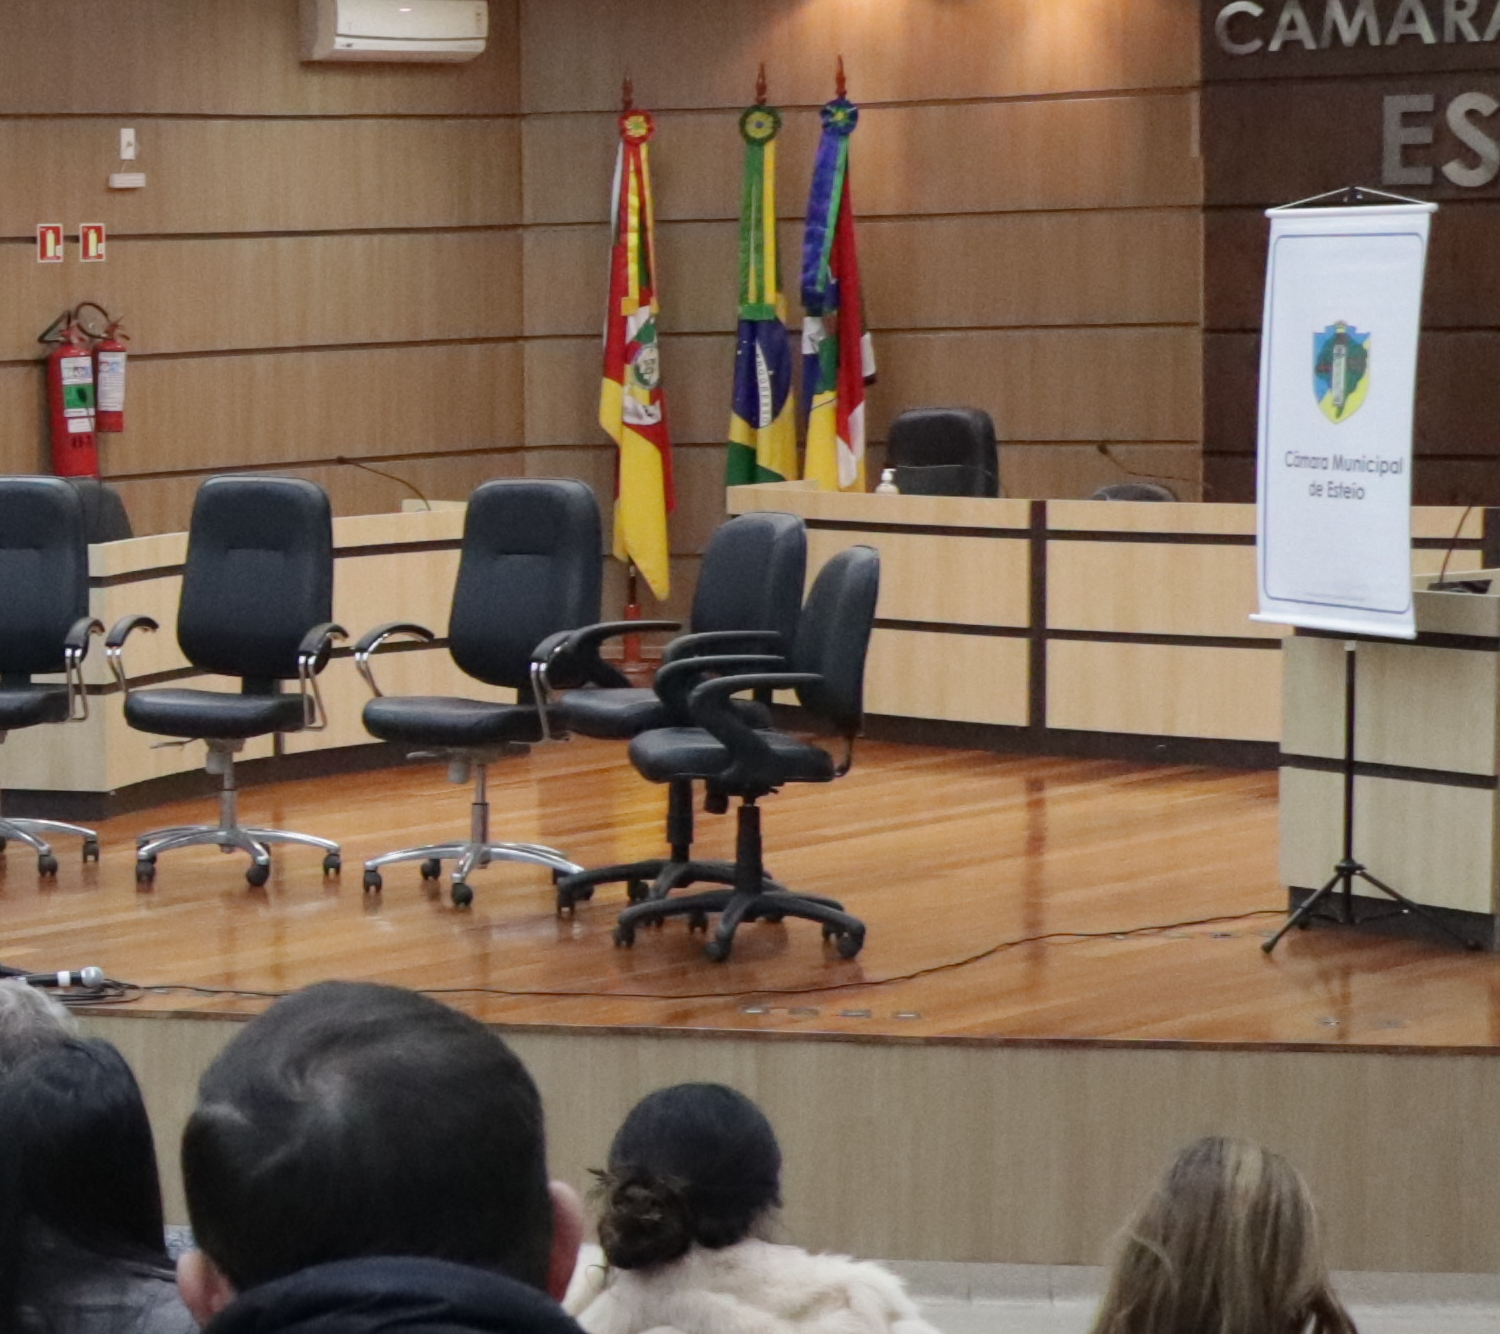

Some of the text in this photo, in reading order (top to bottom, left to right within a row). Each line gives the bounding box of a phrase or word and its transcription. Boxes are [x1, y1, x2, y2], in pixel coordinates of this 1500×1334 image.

[1284, 450, 1403, 477] Câmara Municipal
[1309, 480, 1365, 500] de Esteio
